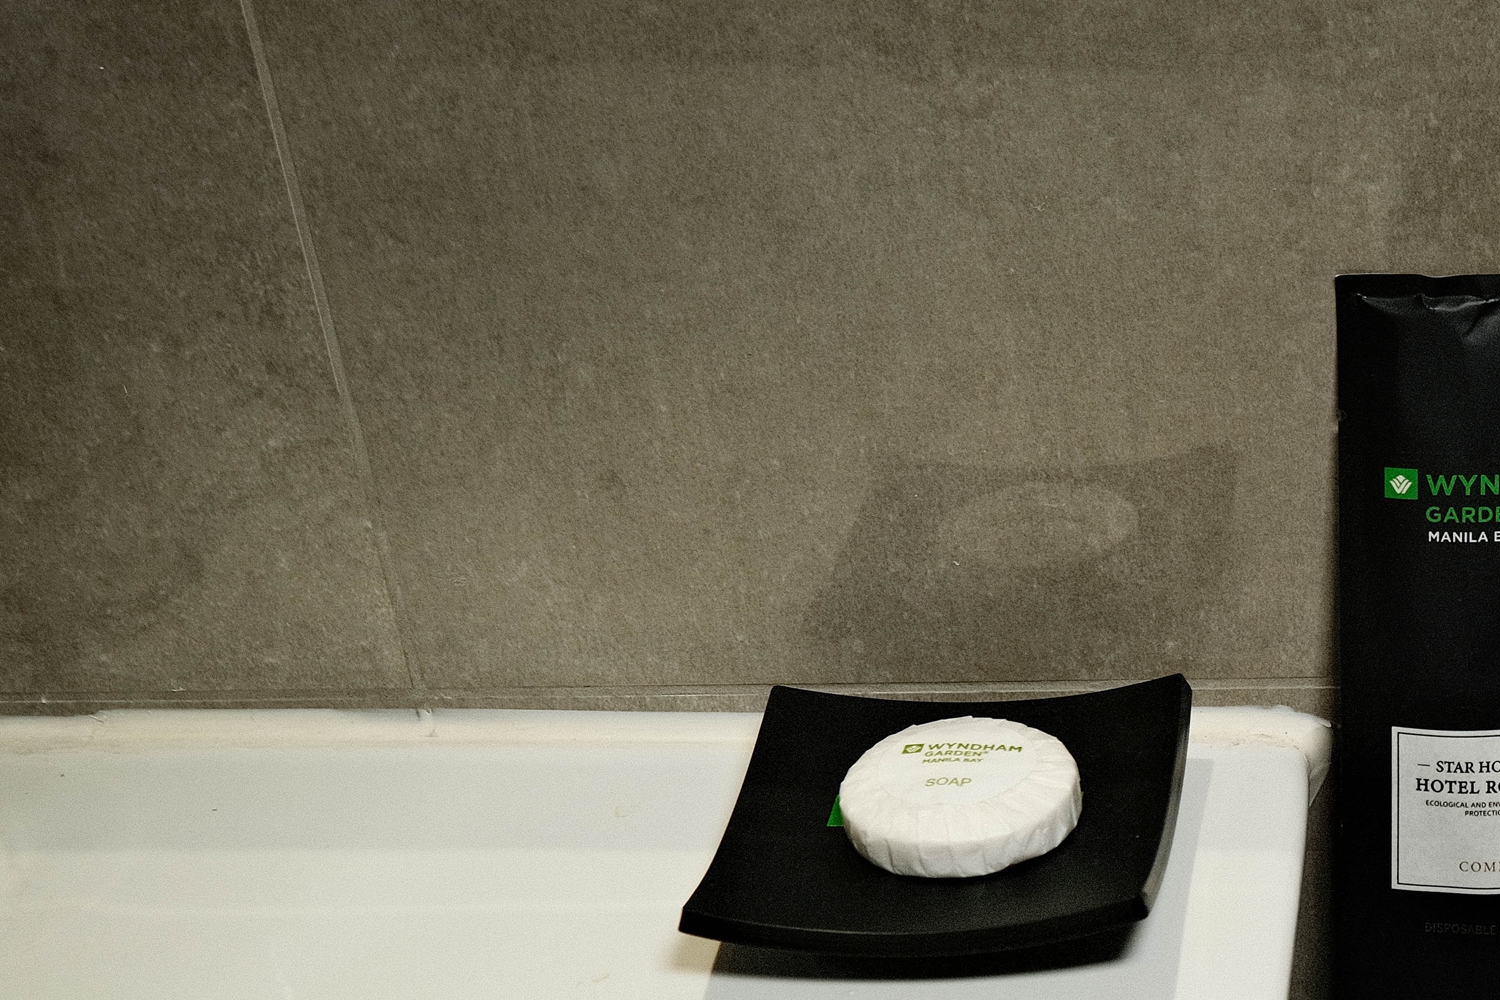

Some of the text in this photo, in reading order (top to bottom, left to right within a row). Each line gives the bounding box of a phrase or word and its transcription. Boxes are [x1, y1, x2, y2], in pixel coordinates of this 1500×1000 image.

[1428, 531, 1488, 543] MANILA
[928, 743, 1022, 752] WYNDHAM
[1436, 761, 1475, 774] STAR
[925, 777, 972, 787] SOAP
[1416, 778, 1480, 794] HOTEL
[1426, 800, 1469, 809] ECOLOGICAL
